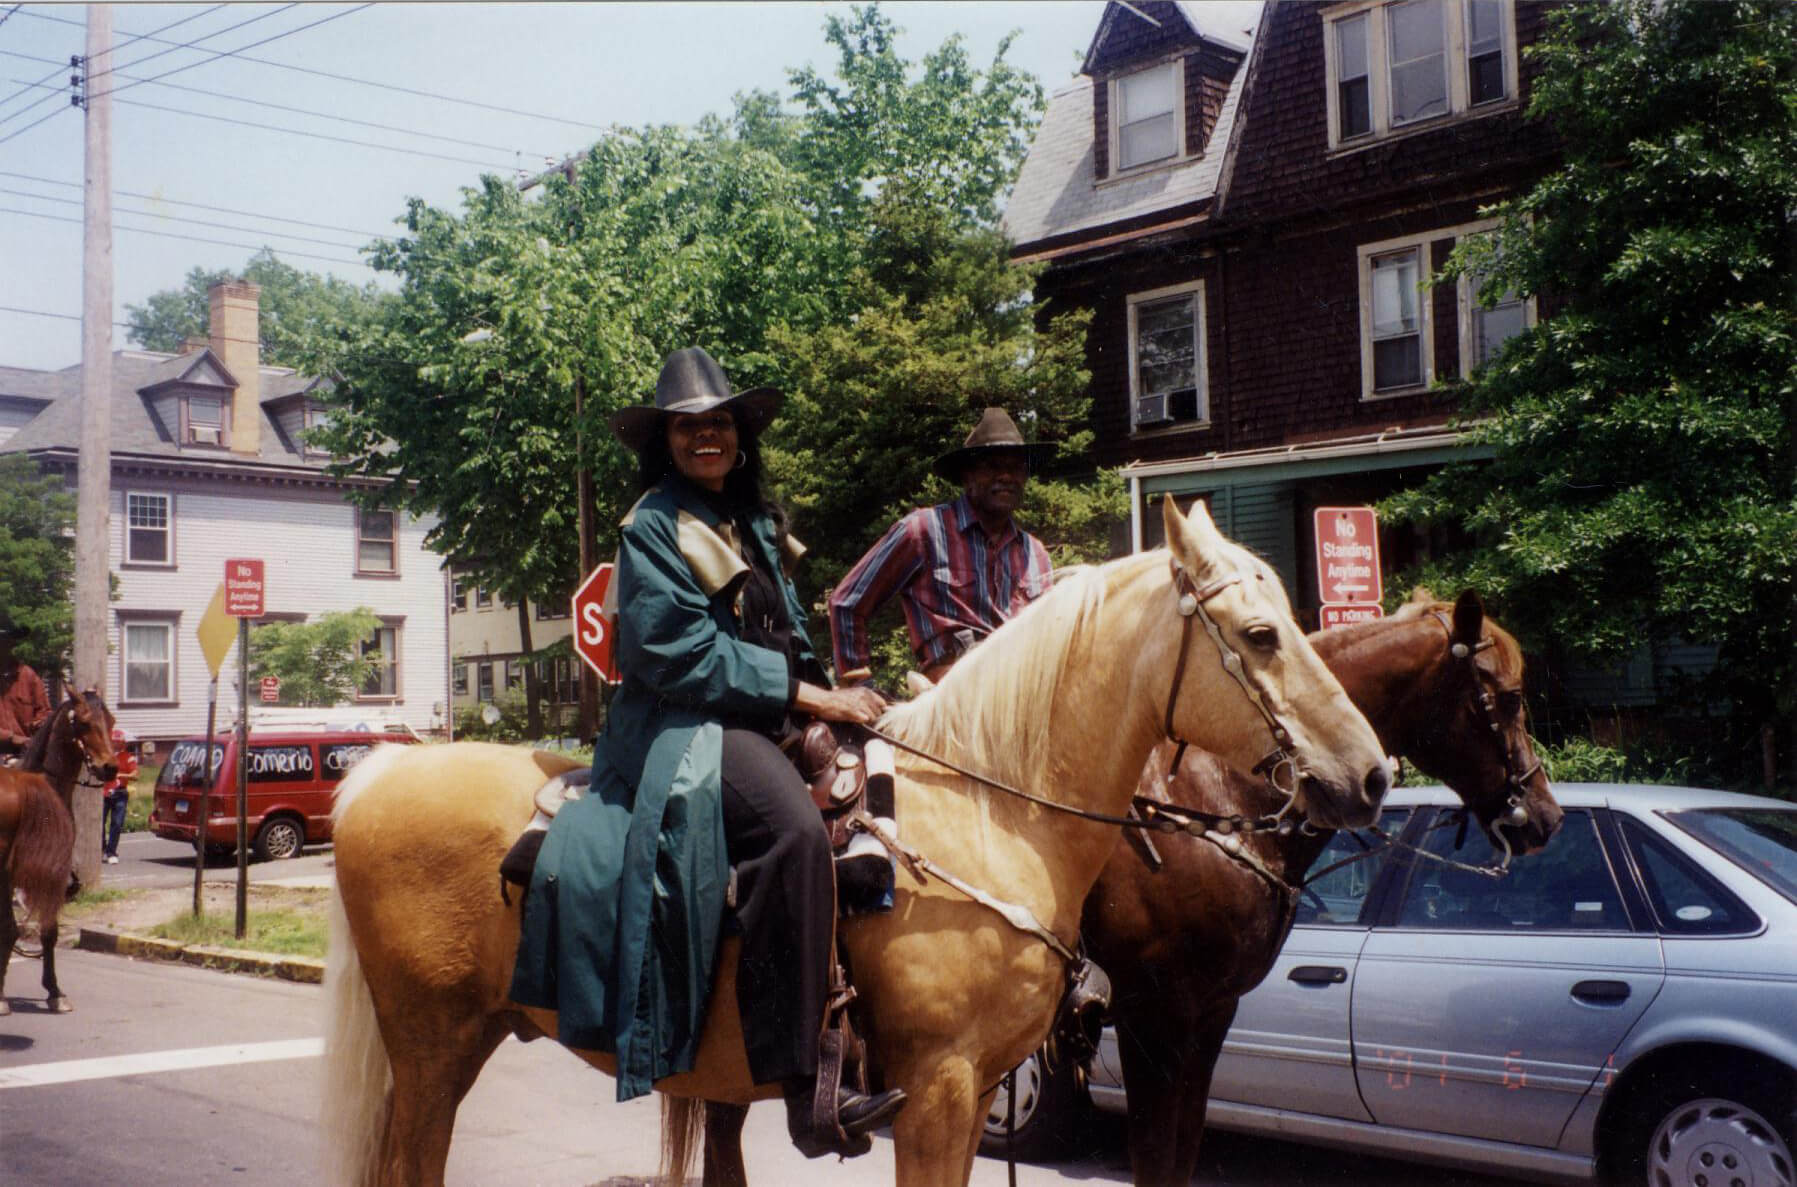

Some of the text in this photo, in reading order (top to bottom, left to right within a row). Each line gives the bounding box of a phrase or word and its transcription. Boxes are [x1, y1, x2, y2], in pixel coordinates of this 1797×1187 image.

[1335, 518, 1356, 538] No
[1323, 541, 1373, 561] Standing
[237, 565, 252, 577] No
[1327, 563, 1371, 581] Anytime
[228, 578, 262, 591] Standing
[230, 591, 259, 602] Anytime
